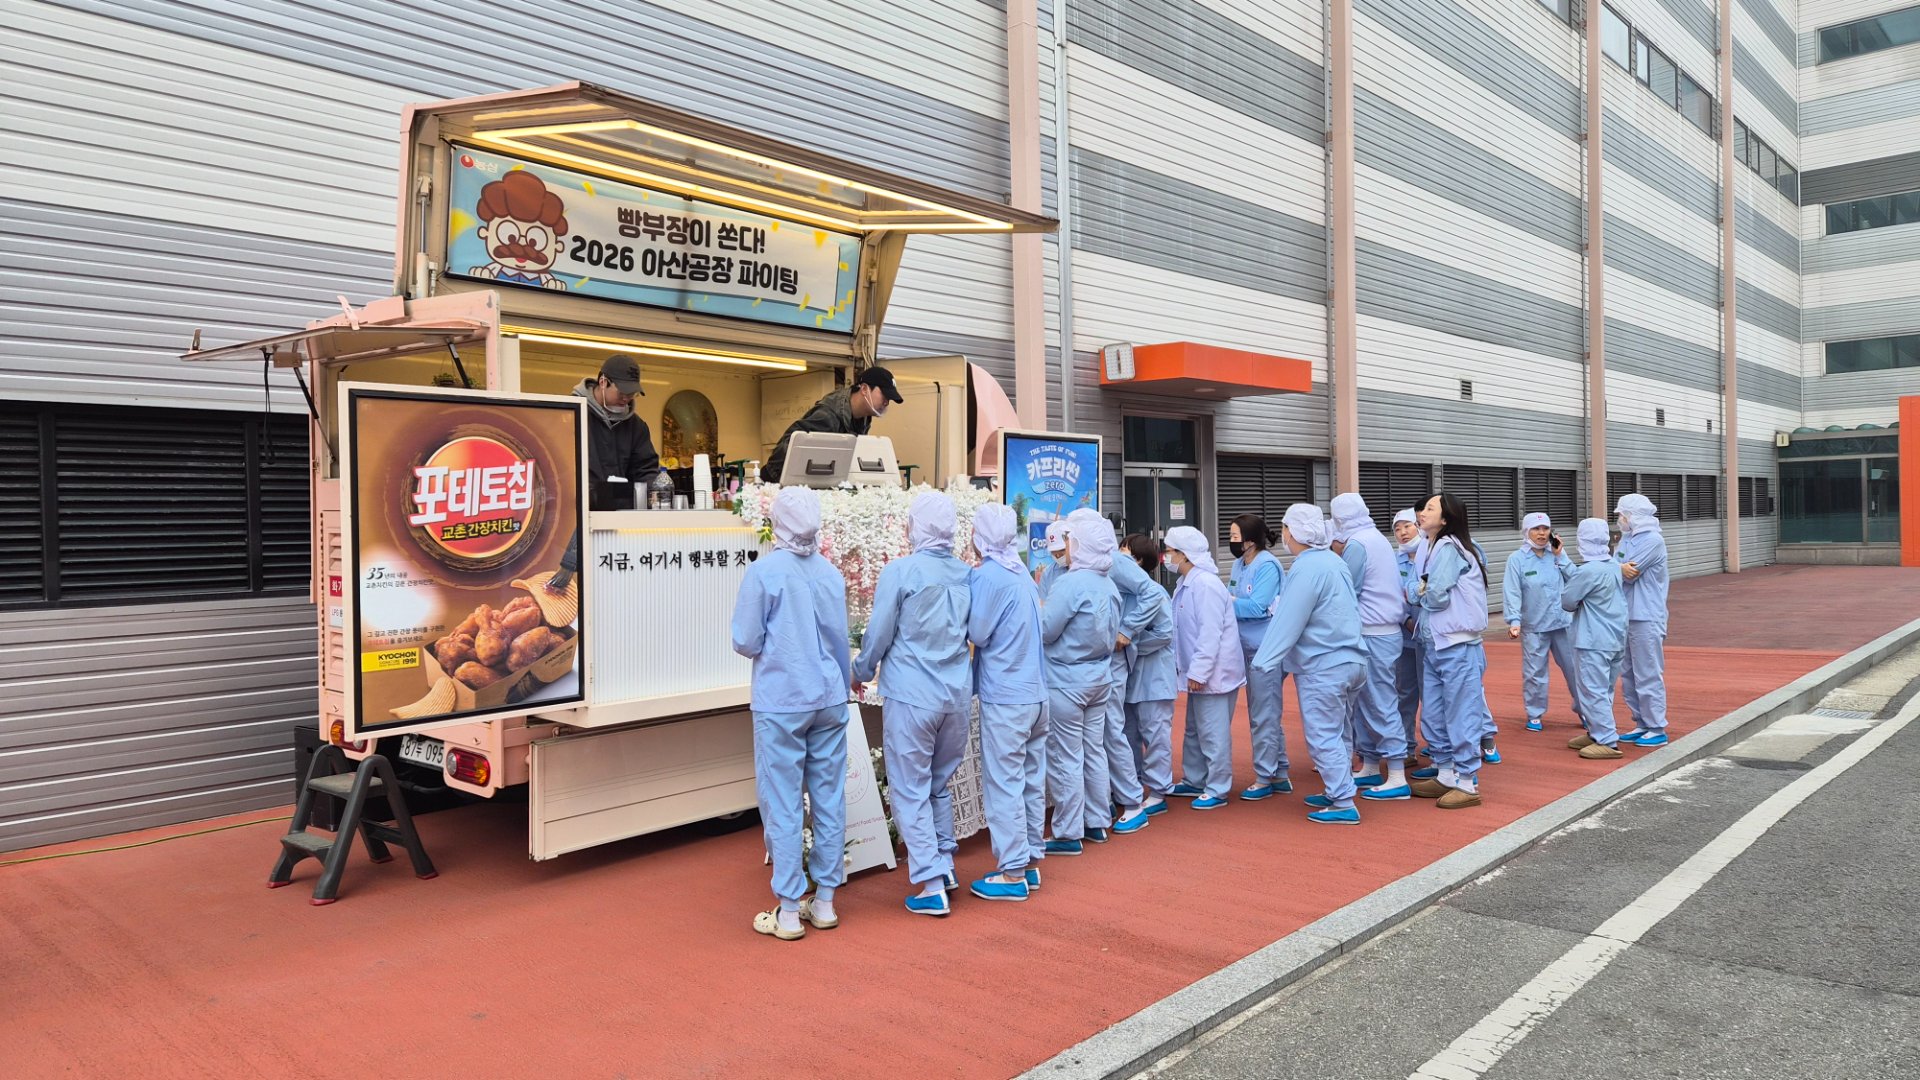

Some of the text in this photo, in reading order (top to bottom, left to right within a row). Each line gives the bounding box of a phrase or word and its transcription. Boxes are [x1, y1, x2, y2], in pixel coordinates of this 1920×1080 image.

[617, 206, 766, 254] 빵부장이 쏜다!
[570, 235, 798, 295] 2026 아산공장 파이팅
[1026, 456, 1080, 484] 카프리썬
[409, 460, 535, 525] 포테토칩
[1044, 481, 1065, 490] zero
[441, 525, 467, 540] 교촌
[598, 552, 634, 572] 지금,
[639, 551, 682, 571] 여기서
[688, 549, 729, 569] 행복할
[378, 651, 417, 661] KYOCHON
